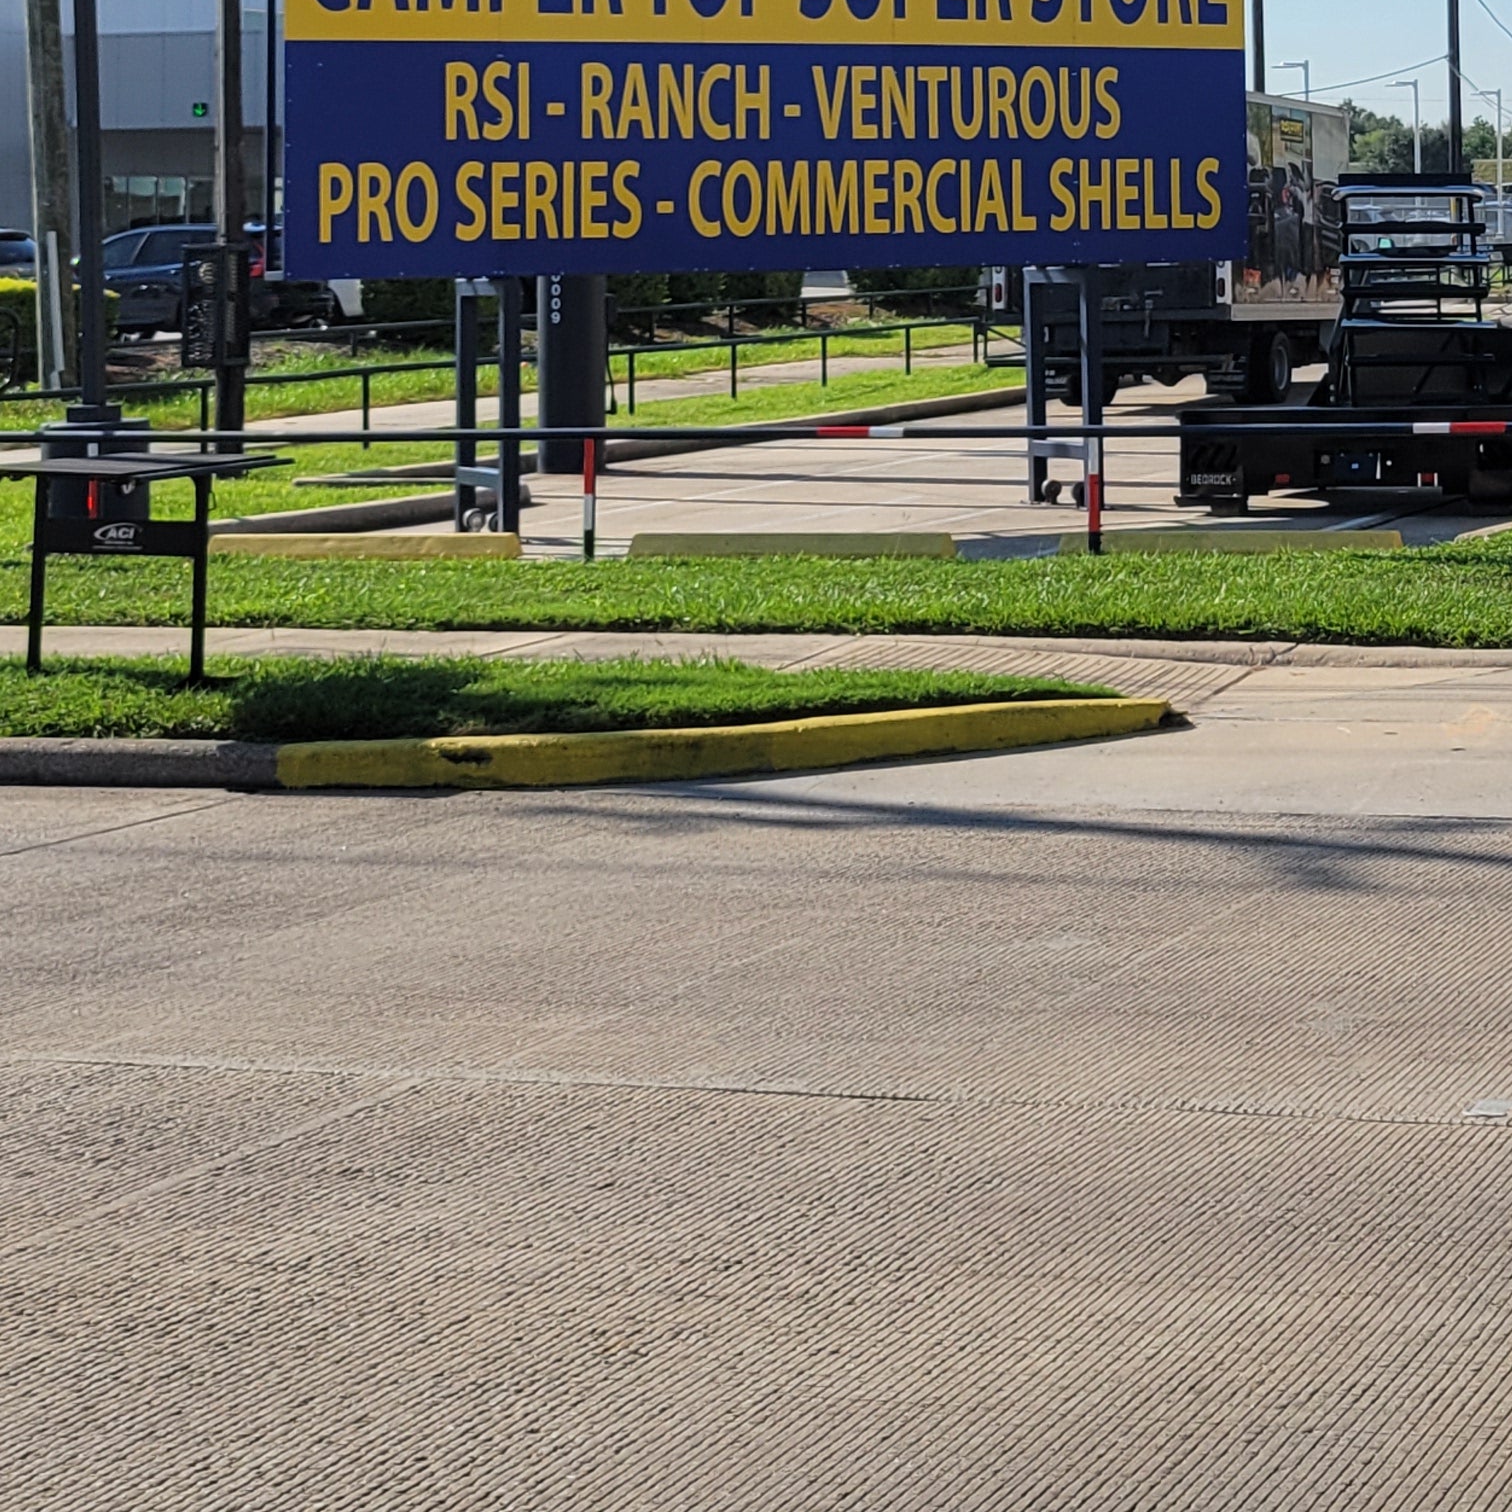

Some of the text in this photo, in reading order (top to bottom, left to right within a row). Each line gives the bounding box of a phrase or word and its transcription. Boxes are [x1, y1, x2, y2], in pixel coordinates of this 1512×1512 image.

[445, 61, 530, 140] RSI
[581, 62, 770, 140] RANCH
[812, 65, 1122, 140] VENTUROUS
[319, 161, 439, 243] PRO
[455, 159, 643, 241] SERIES
[688, 158, 1037, 238] COMMERCIAL
[1049, 157, 1222, 231] SHELLS
[1190, 473, 1232, 485] BEDROCK
[106, 527, 136, 539] ACI
